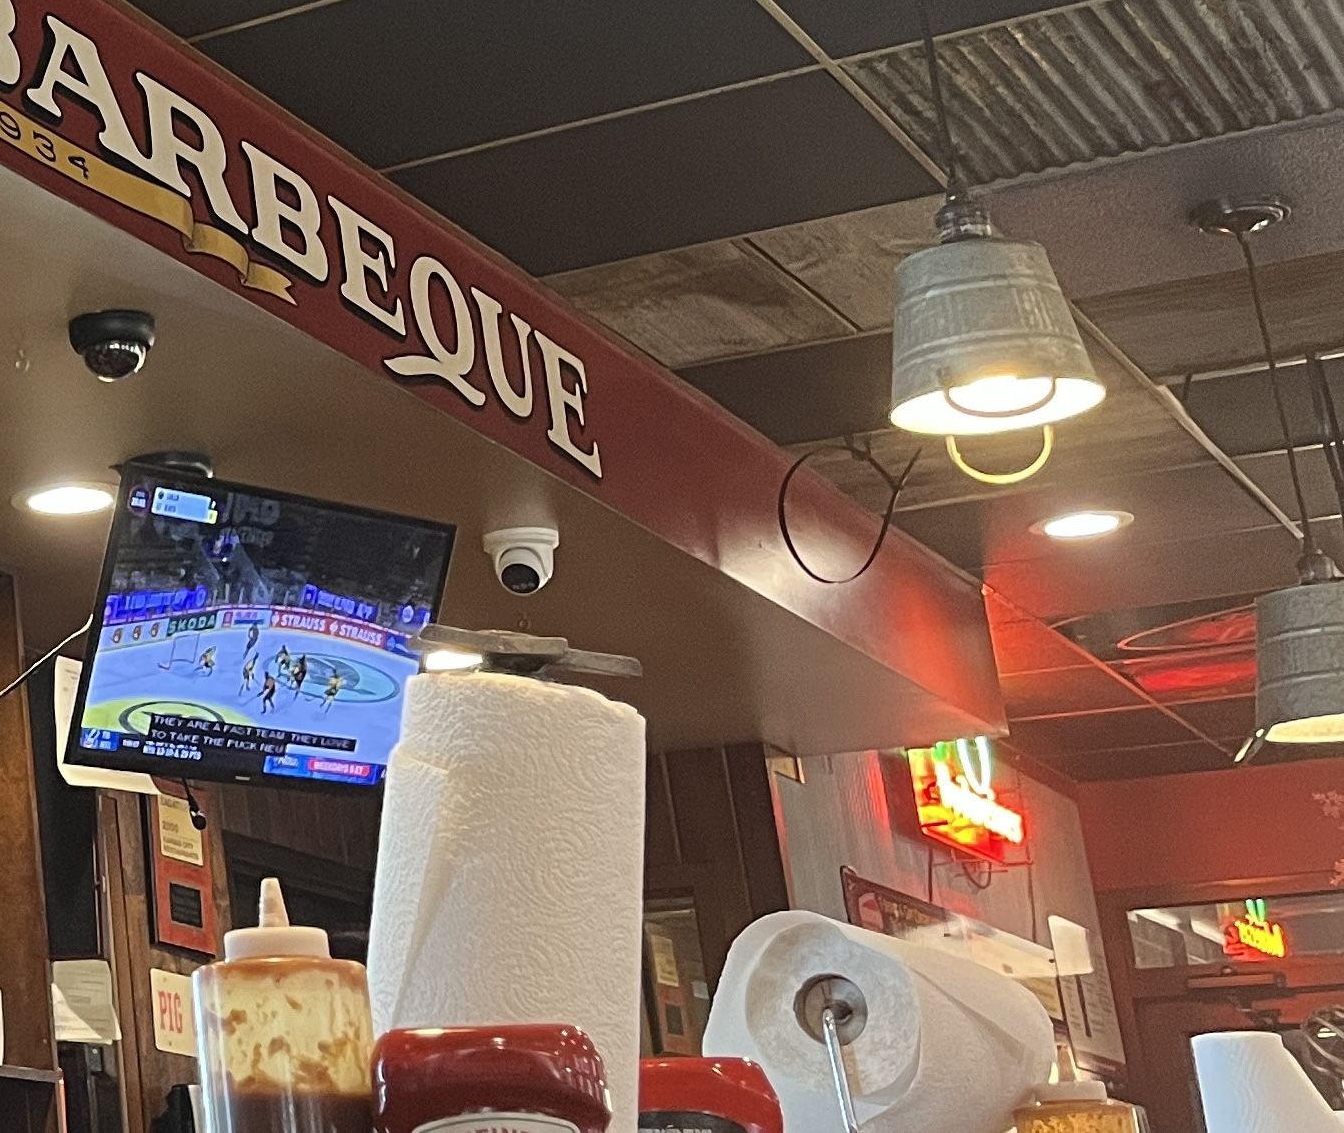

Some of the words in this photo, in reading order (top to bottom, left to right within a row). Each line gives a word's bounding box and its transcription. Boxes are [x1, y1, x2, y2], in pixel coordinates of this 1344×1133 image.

[281, 614, 326, 632] STRAUSS
[339, 624, 383, 646] STRAUSS
[151, 729, 167, 740] TO
[169, 731, 200, 745] TAKE
[202, 735, 225, 747] THE
[226, 738, 258, 751] PUCK
[154, 715, 184, 727] THEY
[186, 720, 211, 732] ARE
[213, 723, 222, 732] A
[223, 724, 254, 736] FAST
[291, 733, 318, 746] THEY
[157, 989, 183, 1035] PIG
